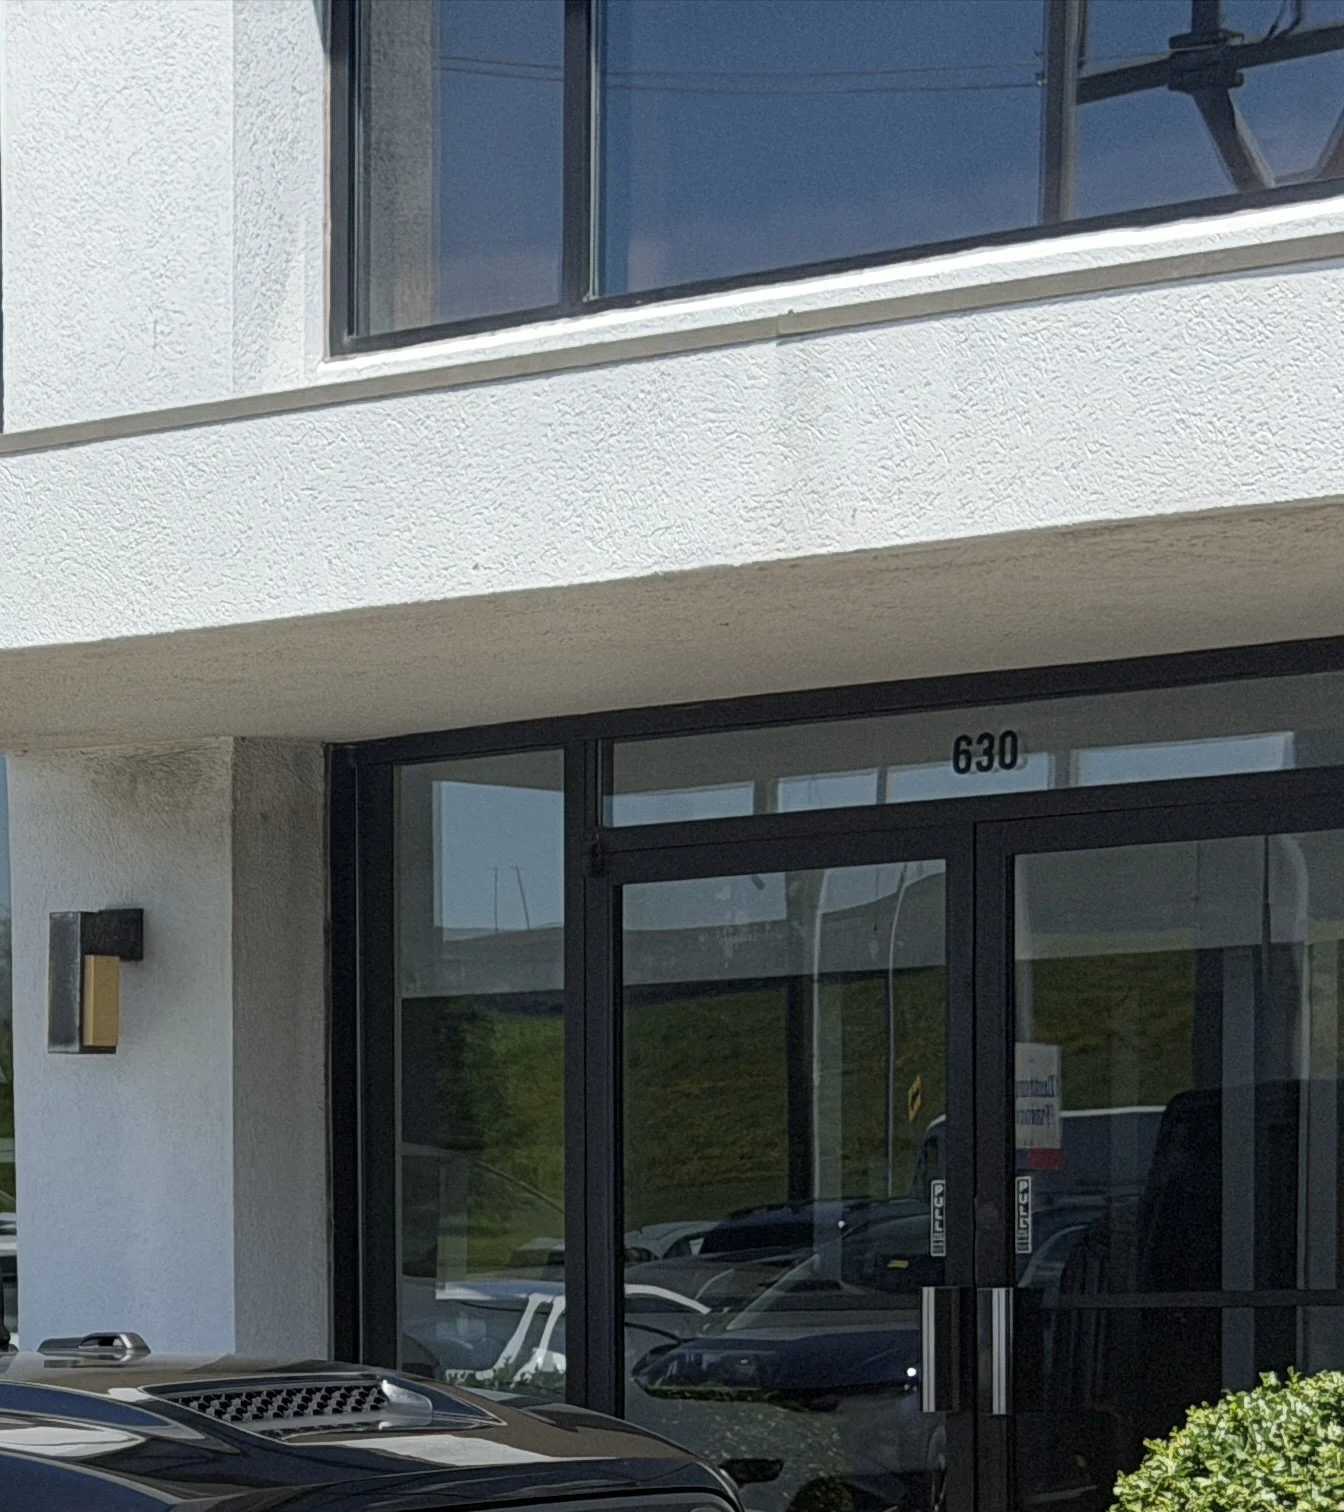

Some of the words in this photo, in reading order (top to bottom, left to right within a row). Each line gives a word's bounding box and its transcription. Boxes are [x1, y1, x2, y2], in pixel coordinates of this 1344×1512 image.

[952, 729, 1019, 775] 630
[933, 1183, 944, 1232] PULL
[1018, 1182, 1028, 1229] PULL
